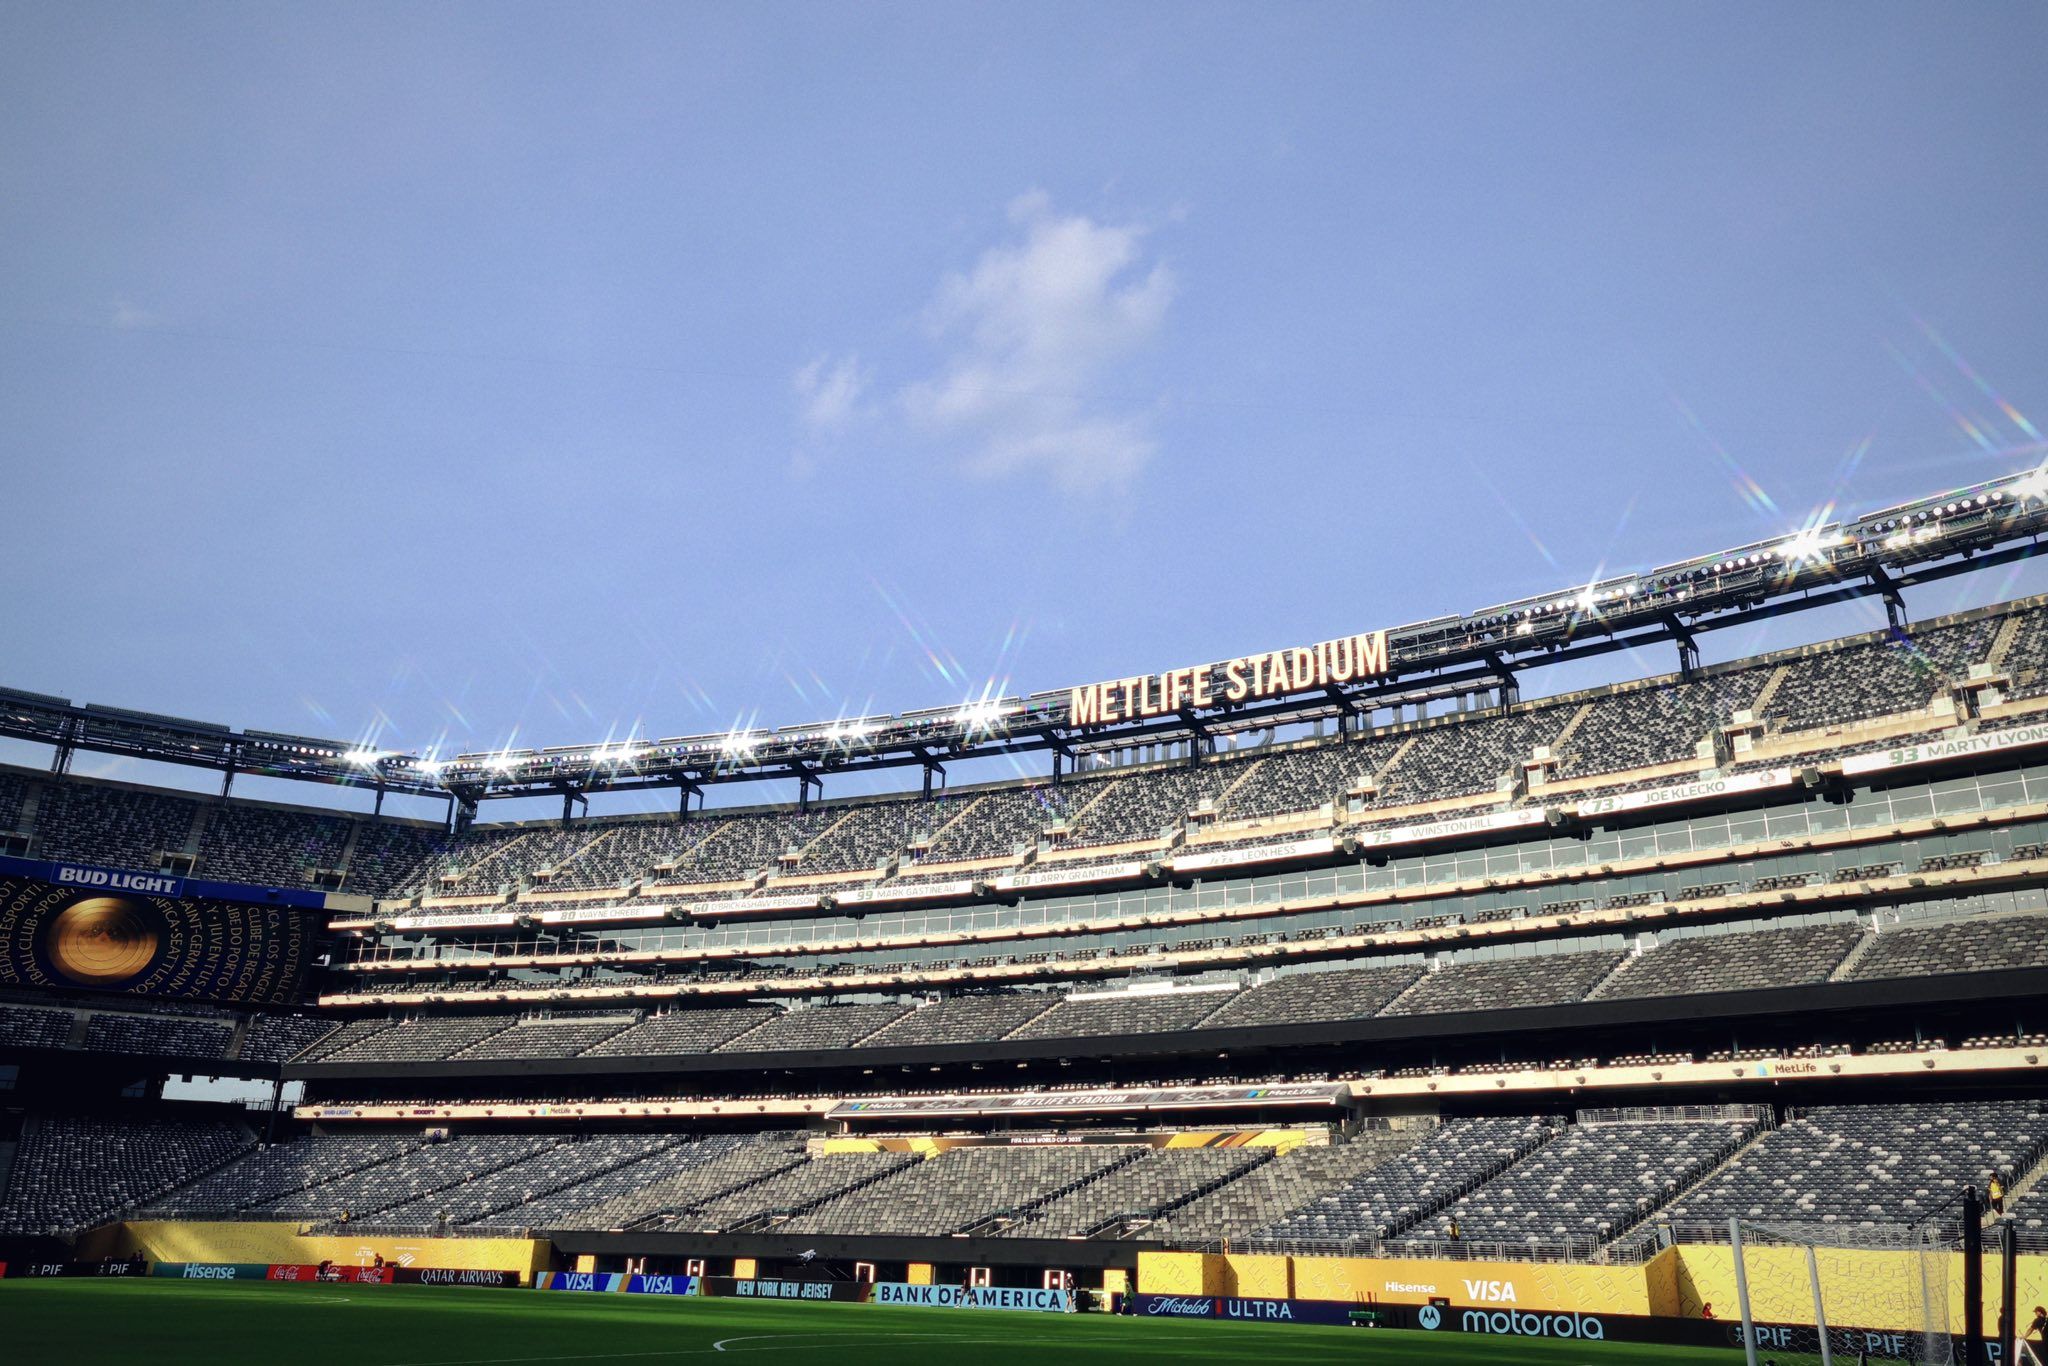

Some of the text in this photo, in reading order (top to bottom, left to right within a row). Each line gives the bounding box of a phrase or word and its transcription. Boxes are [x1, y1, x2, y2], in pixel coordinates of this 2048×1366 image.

[1070, 630, 1389, 726] METLIFE STADIUM
[1889, 747, 1920, 766] 93
[1927, 736, 1992, 757] MARTY
[1593, 781, 1726, 811] 73 JOE KLECKO
[1373, 818, 1495, 844] 75 WINSTON HILL
[1241, 848, 1268, 860] LEON
[1270, 844, 1297, 857] HESS
[58, 867, 176, 894] BUD LIGHT
[1012, 866, 1126, 887] 60 LARRY GRANTHAM
[773, 896, 816, 907] FERGUSON
[857, 884, 956, 900] 99 MARK GASTINEAU
[247, 907, 263, 941] CLUBE
[427, 916, 466, 926] EMERSON
[579, 910, 608, 919] WAYNE
[19, 918, 38, 950] CLUB
[230, 927, 243, 945] DO
[151, 932, 183, 982] SEATTLE
[195, 923, 223, 987] JUVENTUS
[248, 943, 261, 958] DE
[267, 939, 280, 959] LOS
[217, 947, 241, 987] PORTO
[277, 933, 301, 990] FOOTBALL
[1775, 1063, 1818, 1074] MetLife
[1011, 1094, 1130, 1107] METLIFE STADIUM
[41, 1264, 63, 1276] PIF
[108, 1263, 129, 1275] PIF
[182, 1263, 236, 1280] Hisense
[421, 1268, 504, 1286] QATAR AIRWAYS
[564, 1273, 594, 1291] VISA
[641, 1276, 673, 1294] VISA
[736, 1280, 756, 1295] NEW
[757, 1281, 778, 1297] YORK
[780, 1282, 799, 1298] NEW
[1385, 1281, 1436, 1294] Hisense
[1461, 1279, 1517, 1303] VISA
[881, 1286, 1062, 1309] BANK OF AMERICA
[1147, 1296, 1293, 1319] Michelob ULTRA
[1462, 1308, 1604, 1340] motorola
[1755, 1327, 1792, 1347] PIF
[1866, 1333, 1906, 1356] PIF
